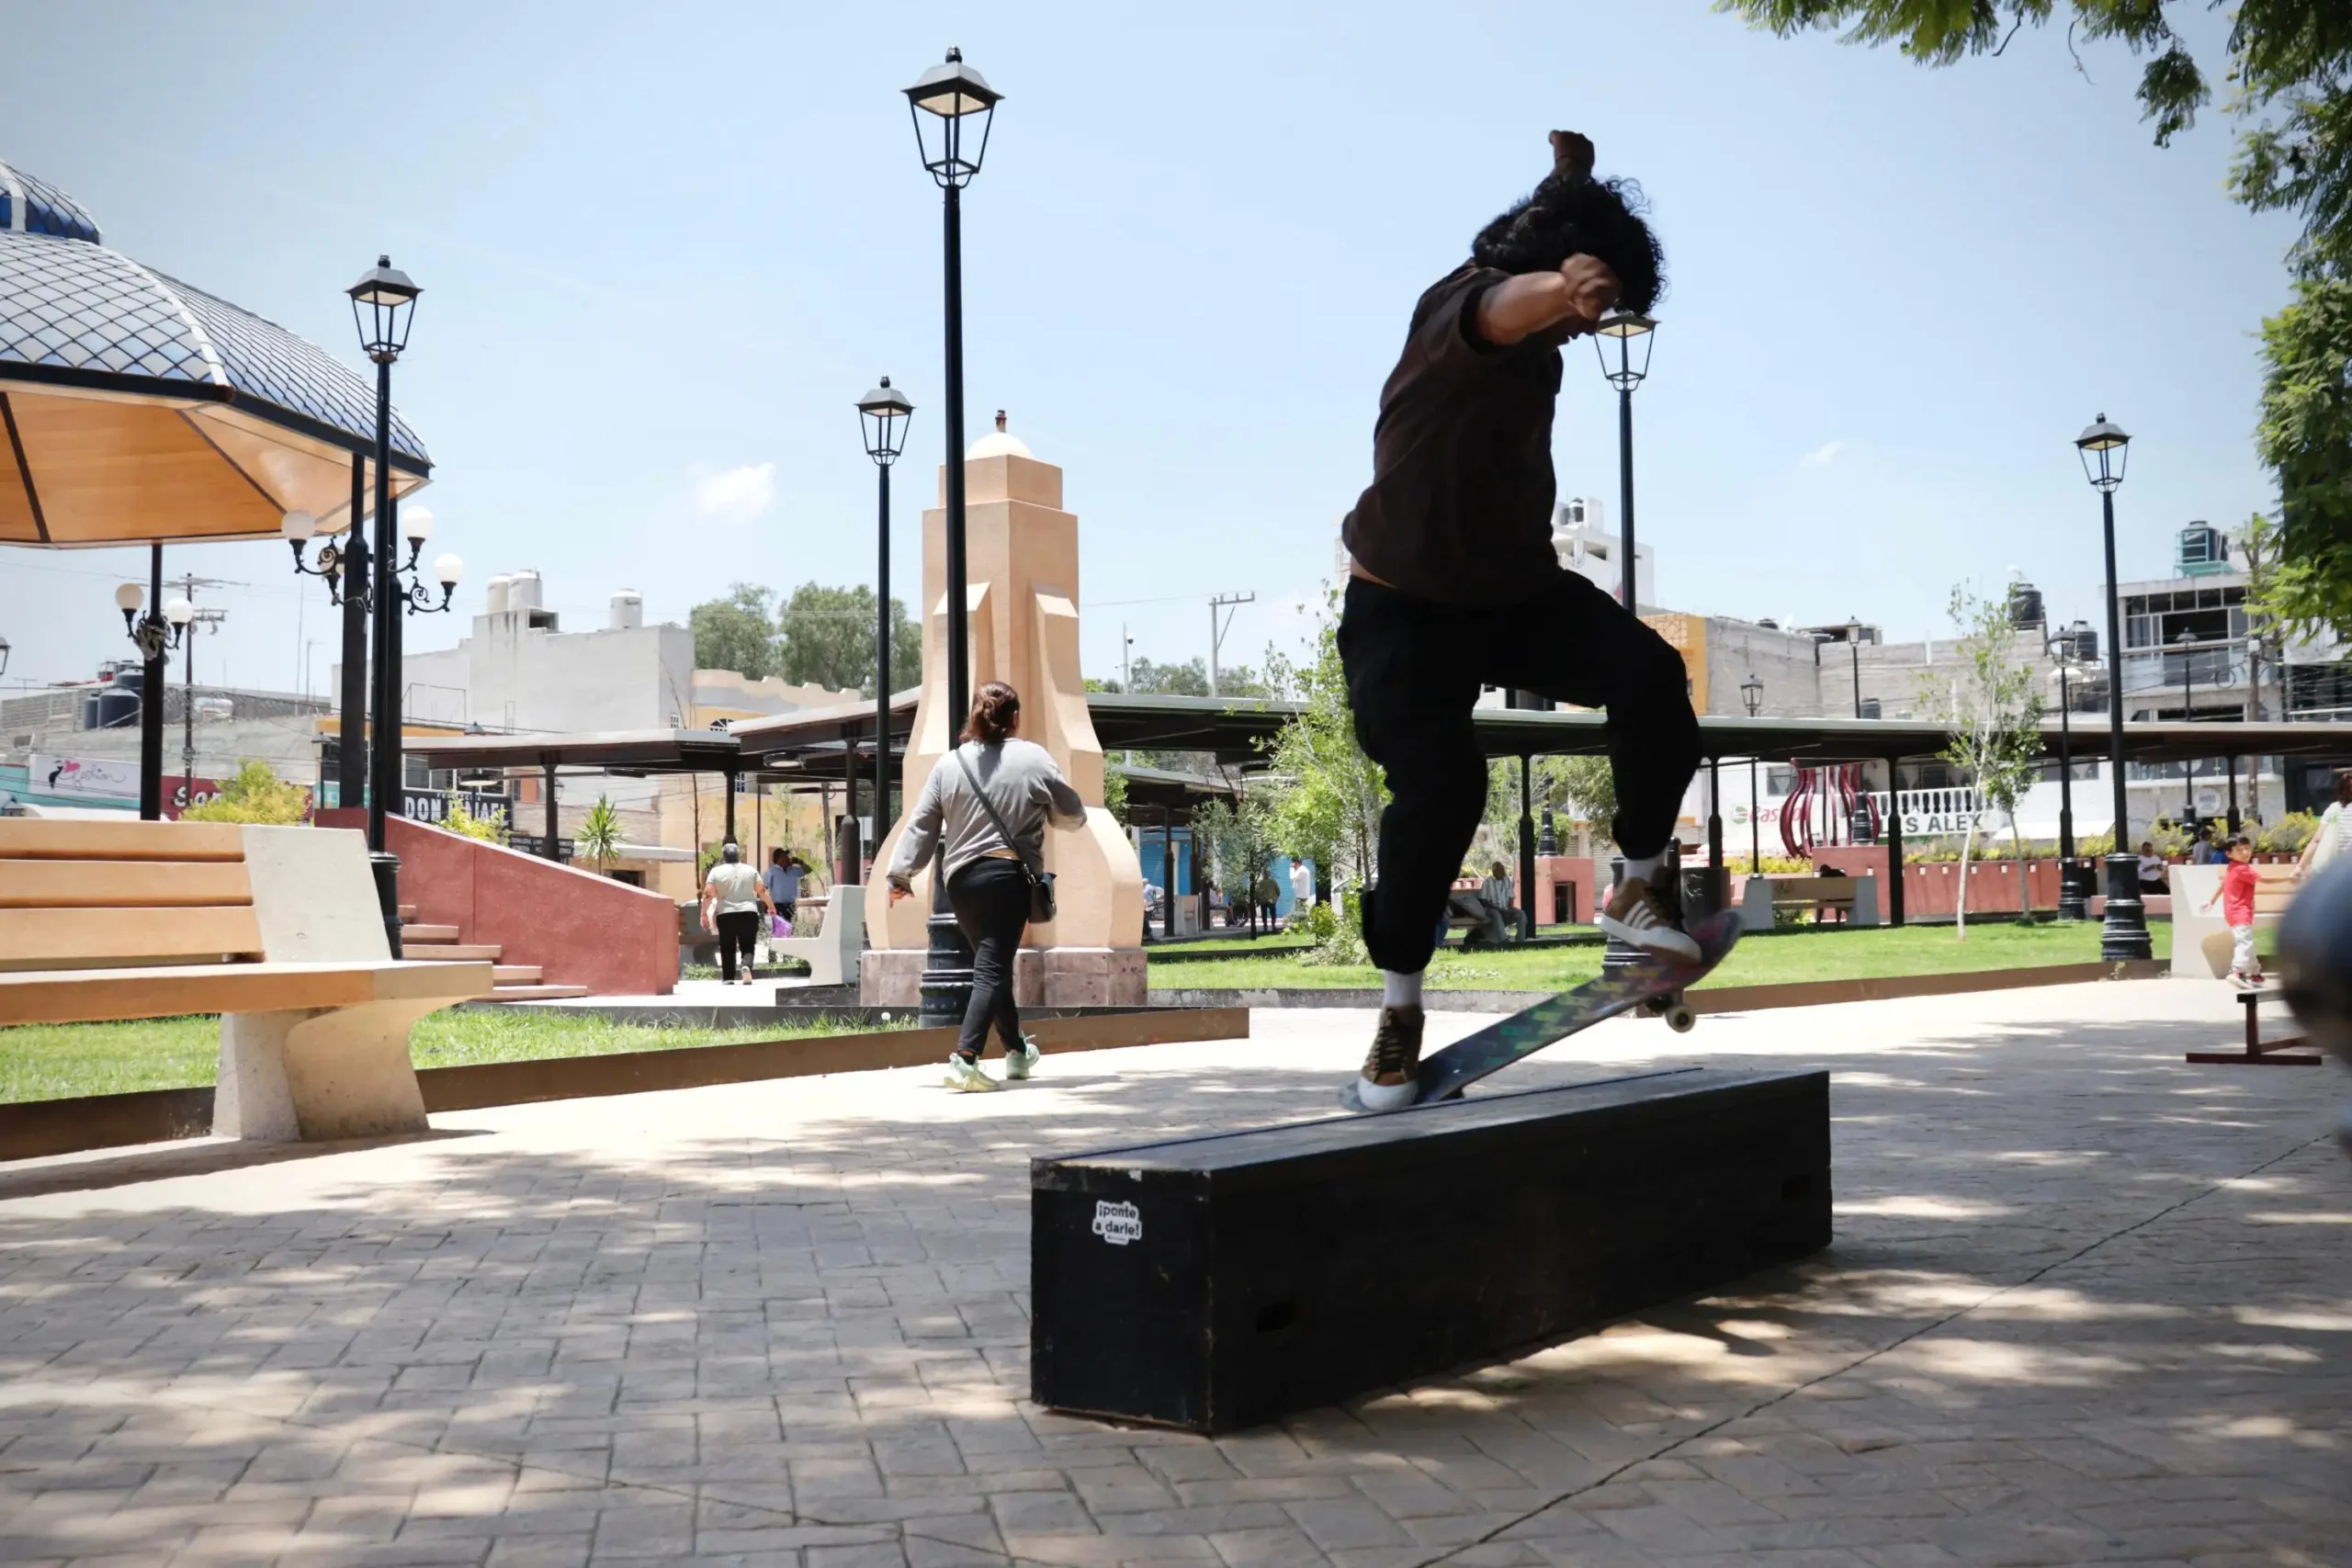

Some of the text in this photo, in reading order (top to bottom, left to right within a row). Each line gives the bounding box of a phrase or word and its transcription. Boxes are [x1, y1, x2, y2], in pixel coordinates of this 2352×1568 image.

[405, 796, 441, 822] DON
[1880, 814, 1983, 833] LS ALEX
[1099, 1204, 1136, 1218] ¡ponte
[1095, 1221, 1139, 1235] a darle!
